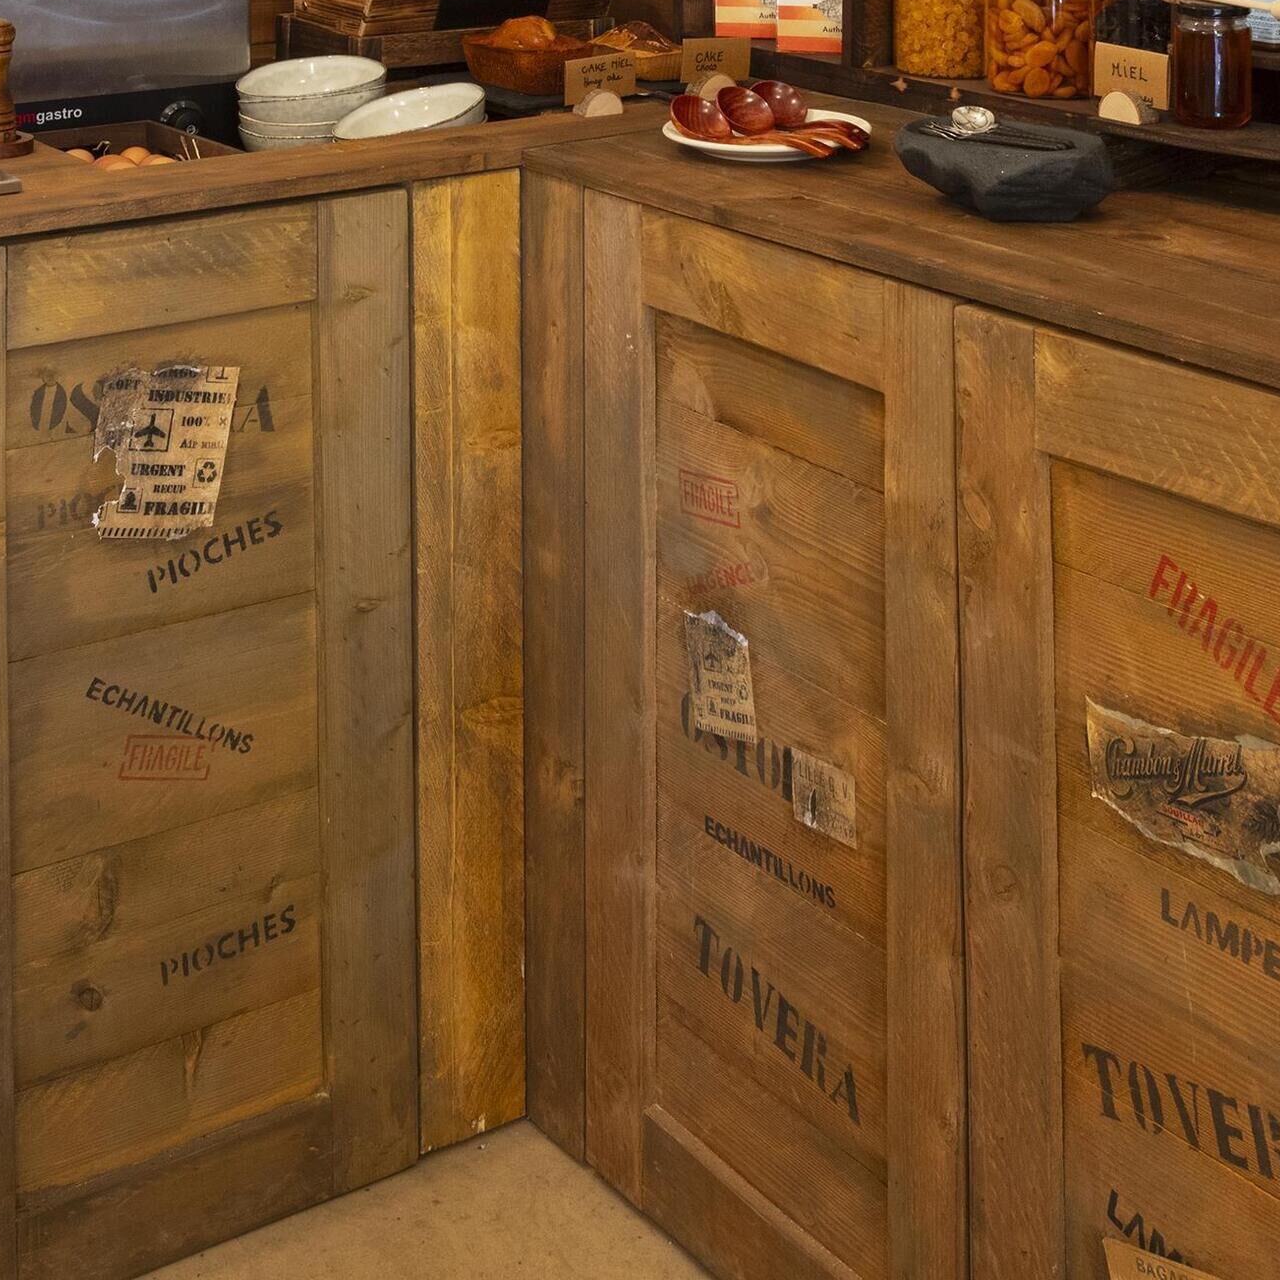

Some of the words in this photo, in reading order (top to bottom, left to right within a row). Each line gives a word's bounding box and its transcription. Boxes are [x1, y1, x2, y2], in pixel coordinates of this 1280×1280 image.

[129, 462, 187, 478] URGENT
[152, 483, 187, 495] RECUP
[683, 479, 734, 517] FRAGILE
[146, 510, 284, 594] PIOCHES
[85, 676, 255, 754] ECHANTILLONS
[127, 743, 207, 772] FRAGILE
[704, 815, 836, 910] ECHANTILLONS
[160, 904, 297, 987] PIOCHES
[692, 913, 861, 1126] TOVERA
